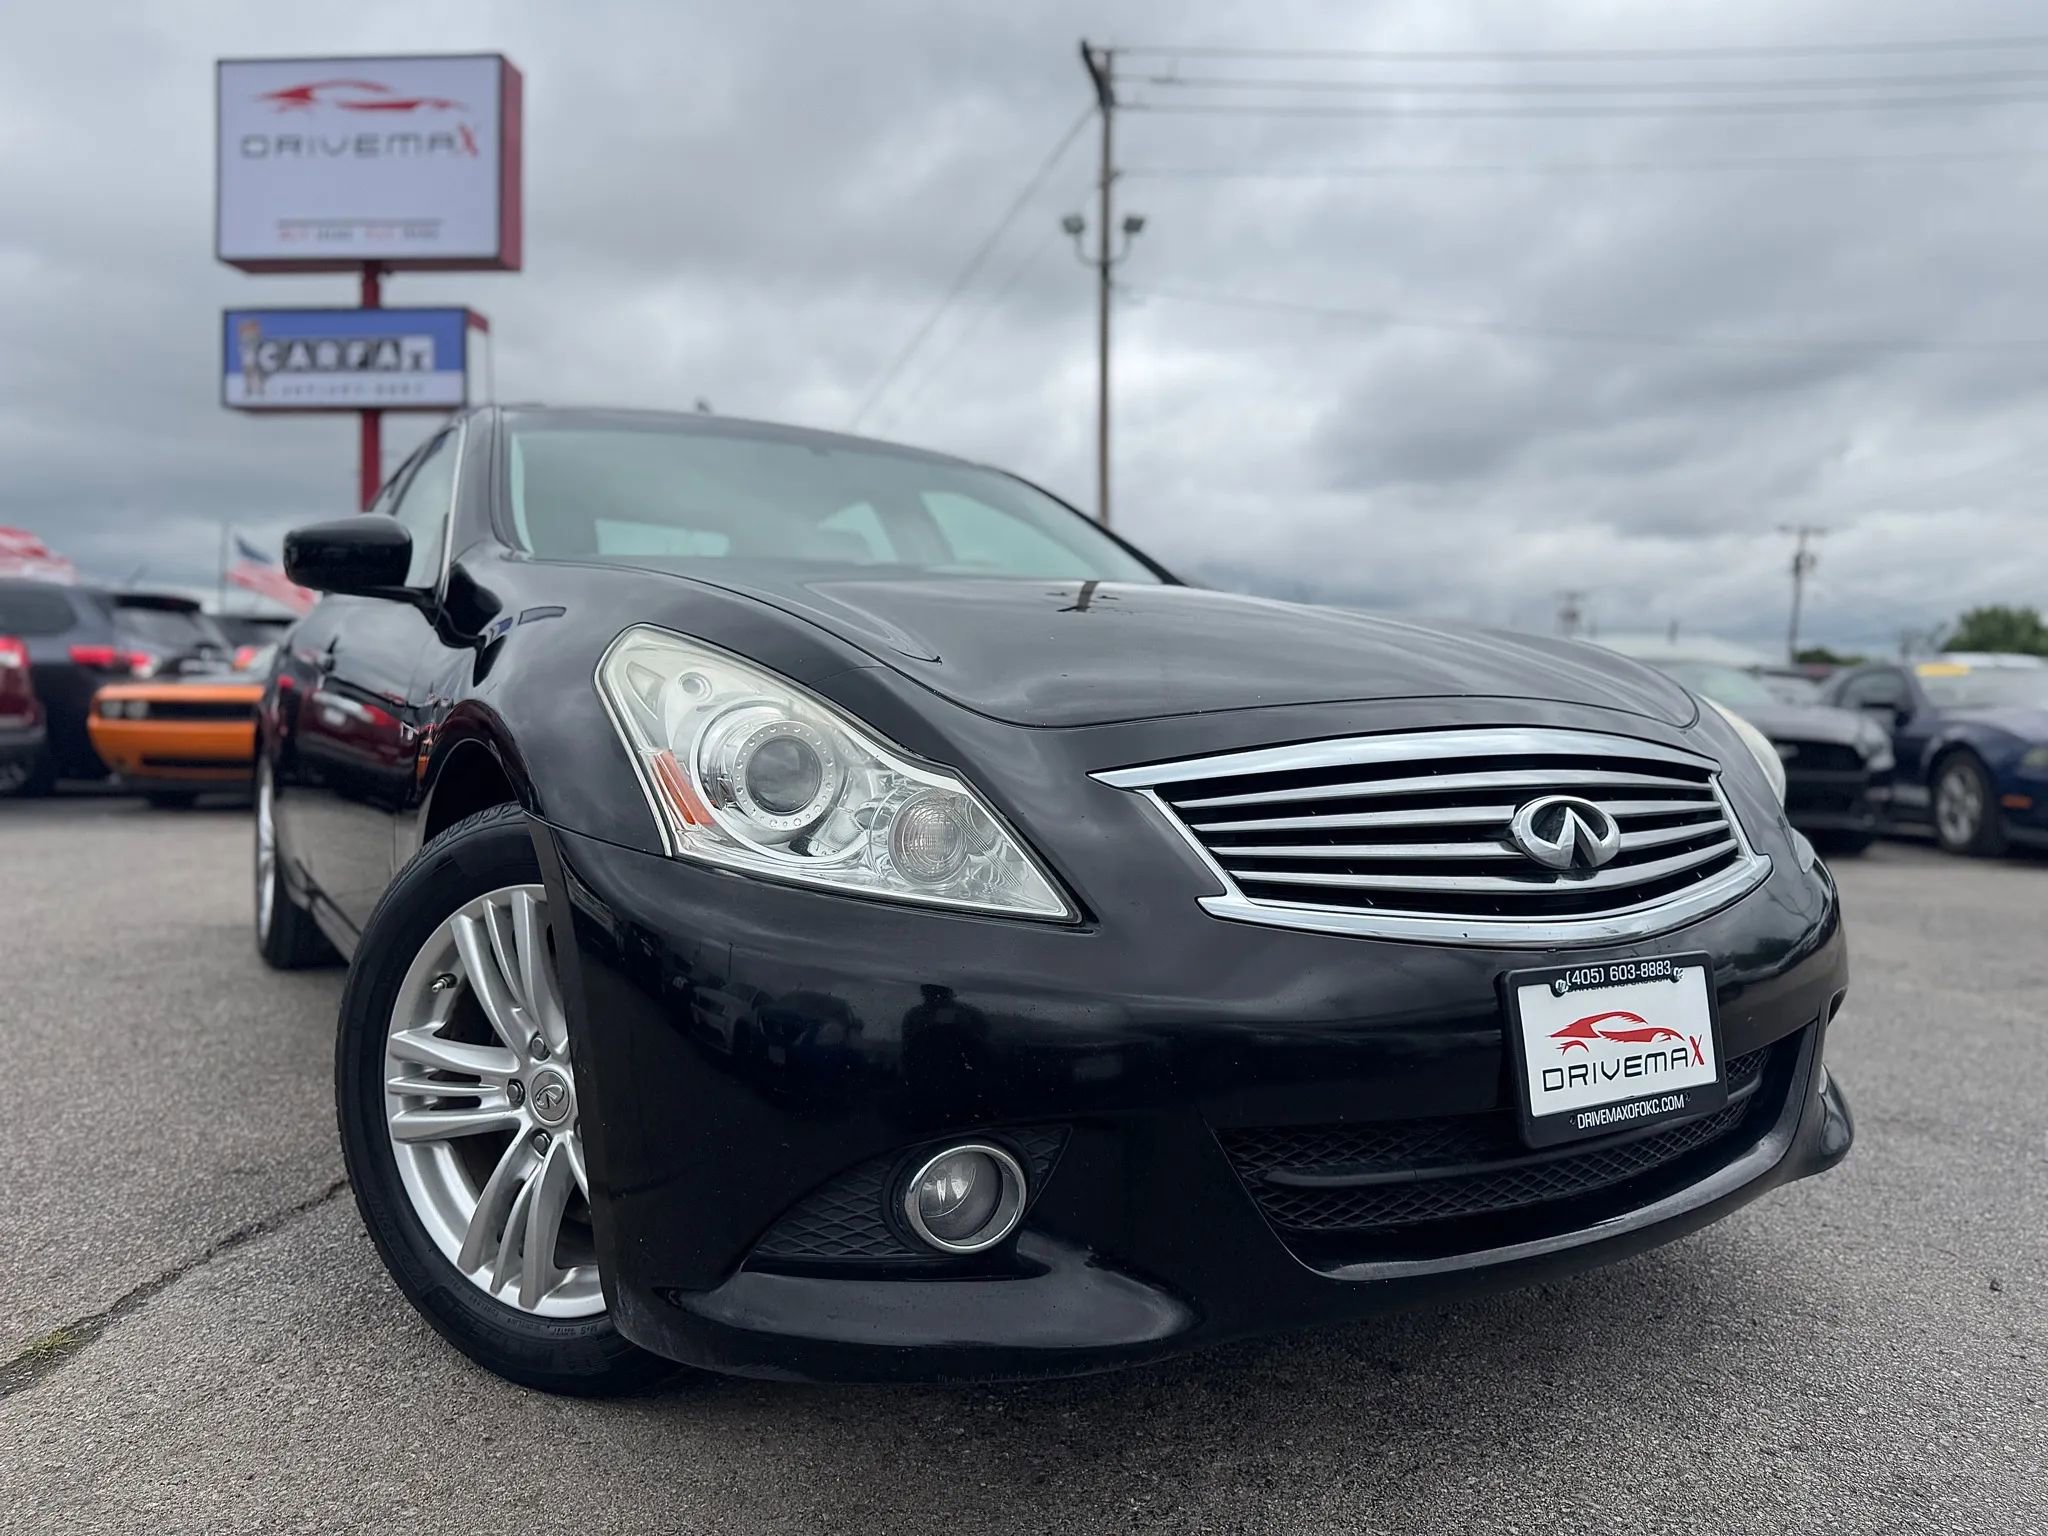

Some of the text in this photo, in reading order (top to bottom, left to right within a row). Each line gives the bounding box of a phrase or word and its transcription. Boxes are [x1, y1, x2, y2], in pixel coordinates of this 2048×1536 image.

[240, 122, 479, 159] DRIVEMAX
[1565, 967, 1604, 986] (405)
[1610, 960, 1671, 980] 603-8883
[1542, 1035, 1704, 1091] DRIVEMAX
[1577, 1095, 1684, 1129] DRIVEMAXOFOKC.COM
